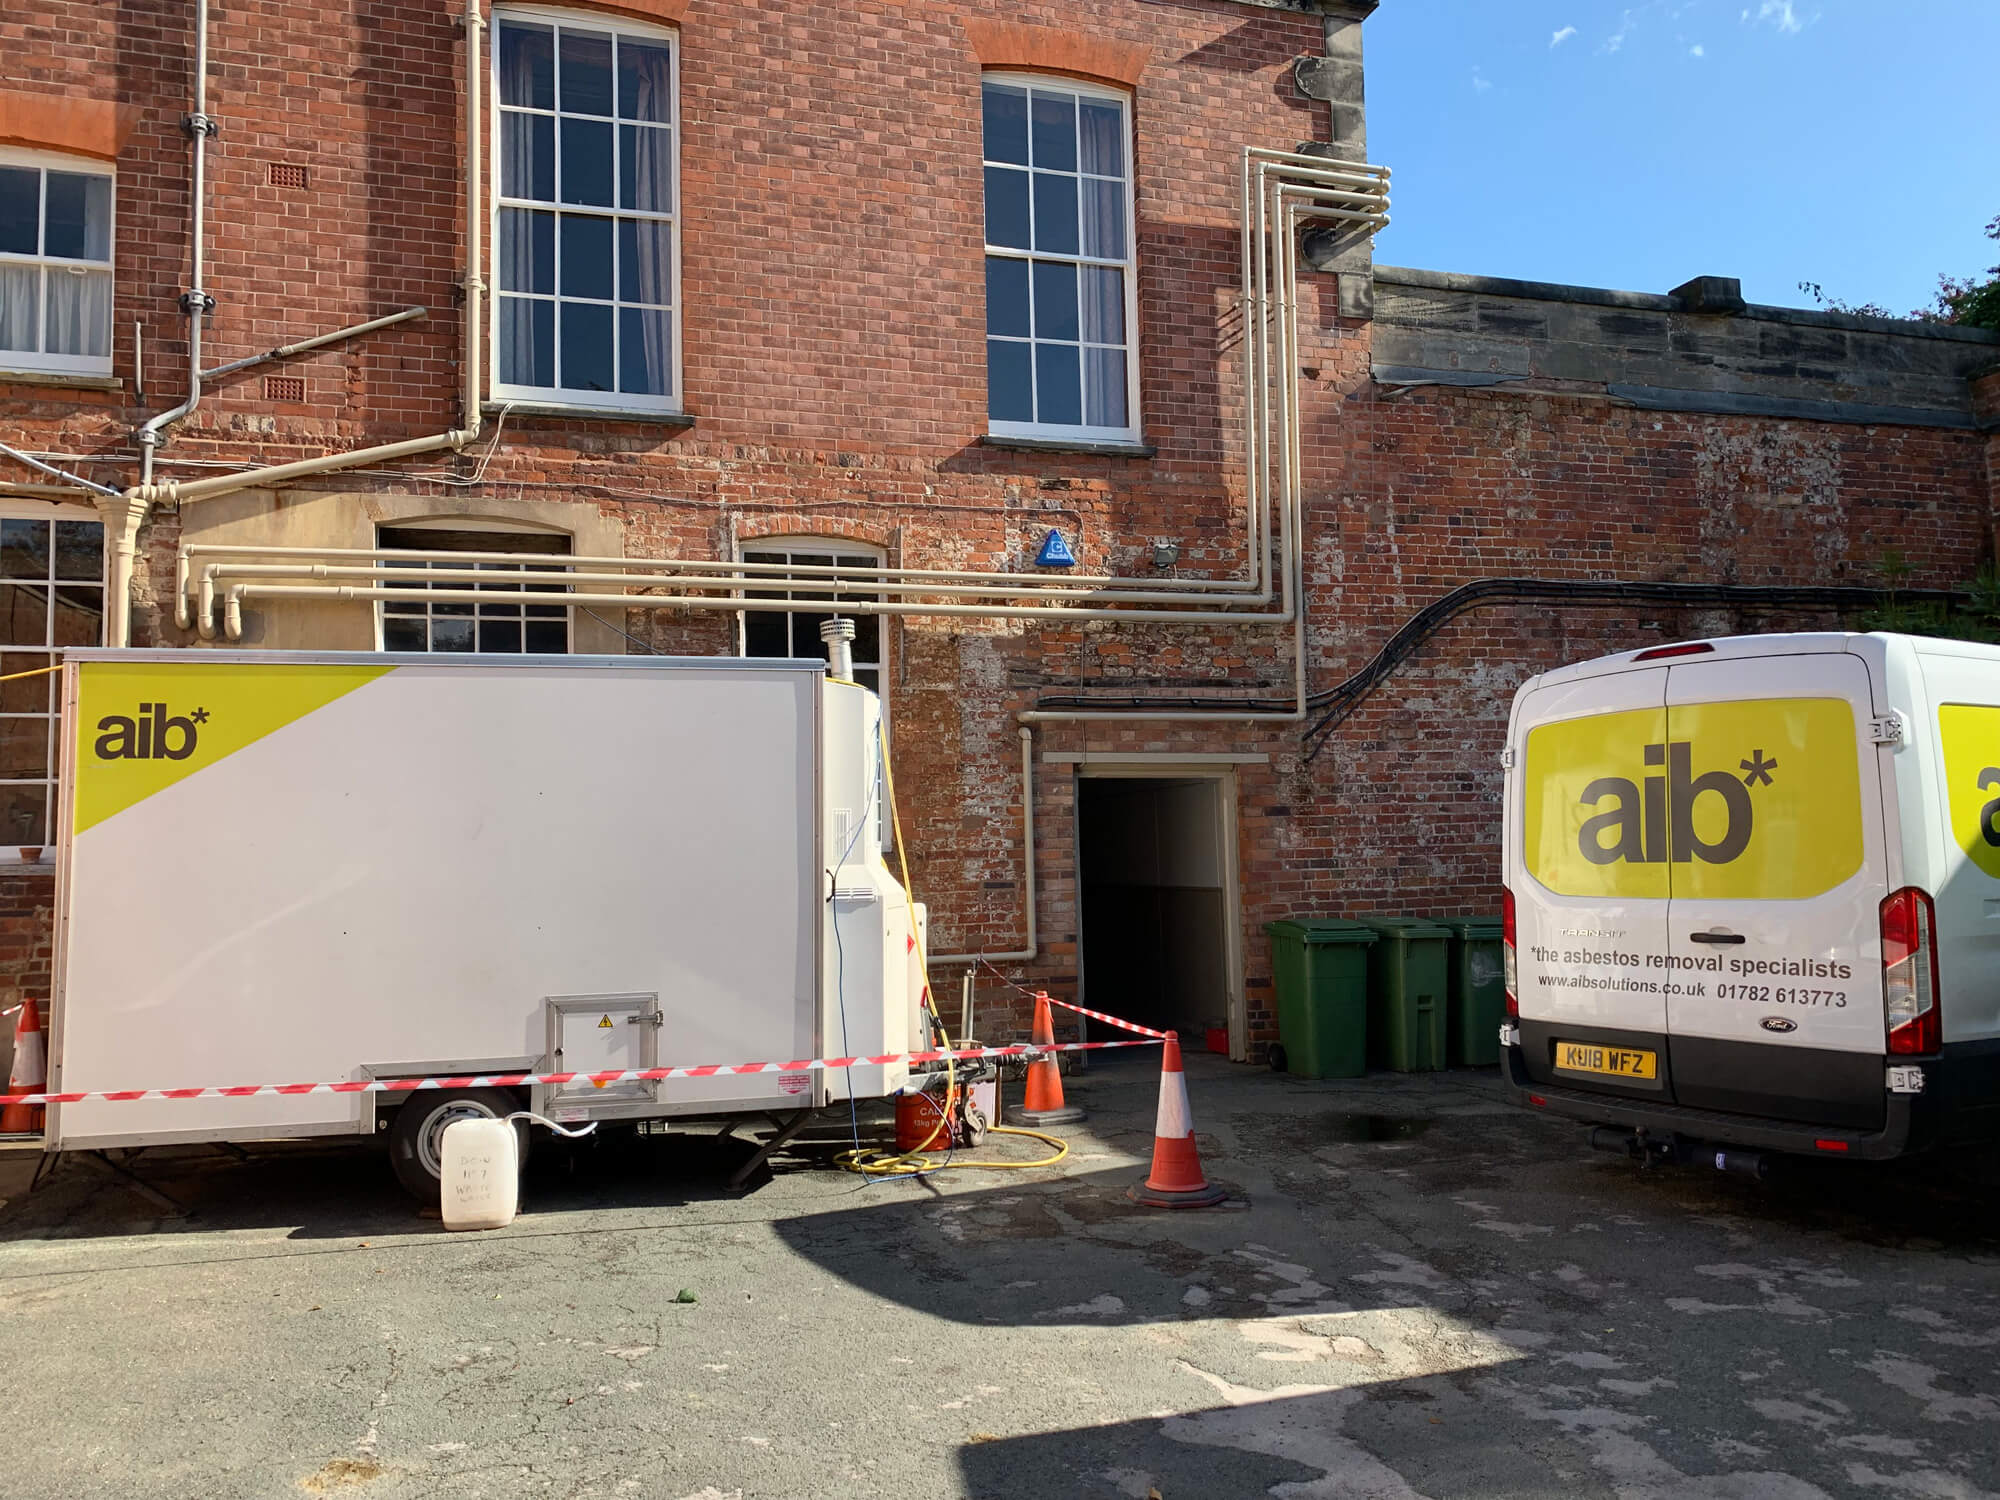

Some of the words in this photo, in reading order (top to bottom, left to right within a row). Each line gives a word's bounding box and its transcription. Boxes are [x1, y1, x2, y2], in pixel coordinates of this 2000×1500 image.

[1563, 948, 1640, 967] asbestos
[1646, 953, 1723, 972] removal
[1730, 957, 1852, 979] specialists
[1538, 974, 1706, 997] www.aibsolutions.co.uk
[1717, 983, 1770, 1002] 01782
[1775, 987, 1847, 1008] 613773
[1566, 1047, 1603, 1069] KU18
[1609, 1051, 1643, 1074] WFZ
